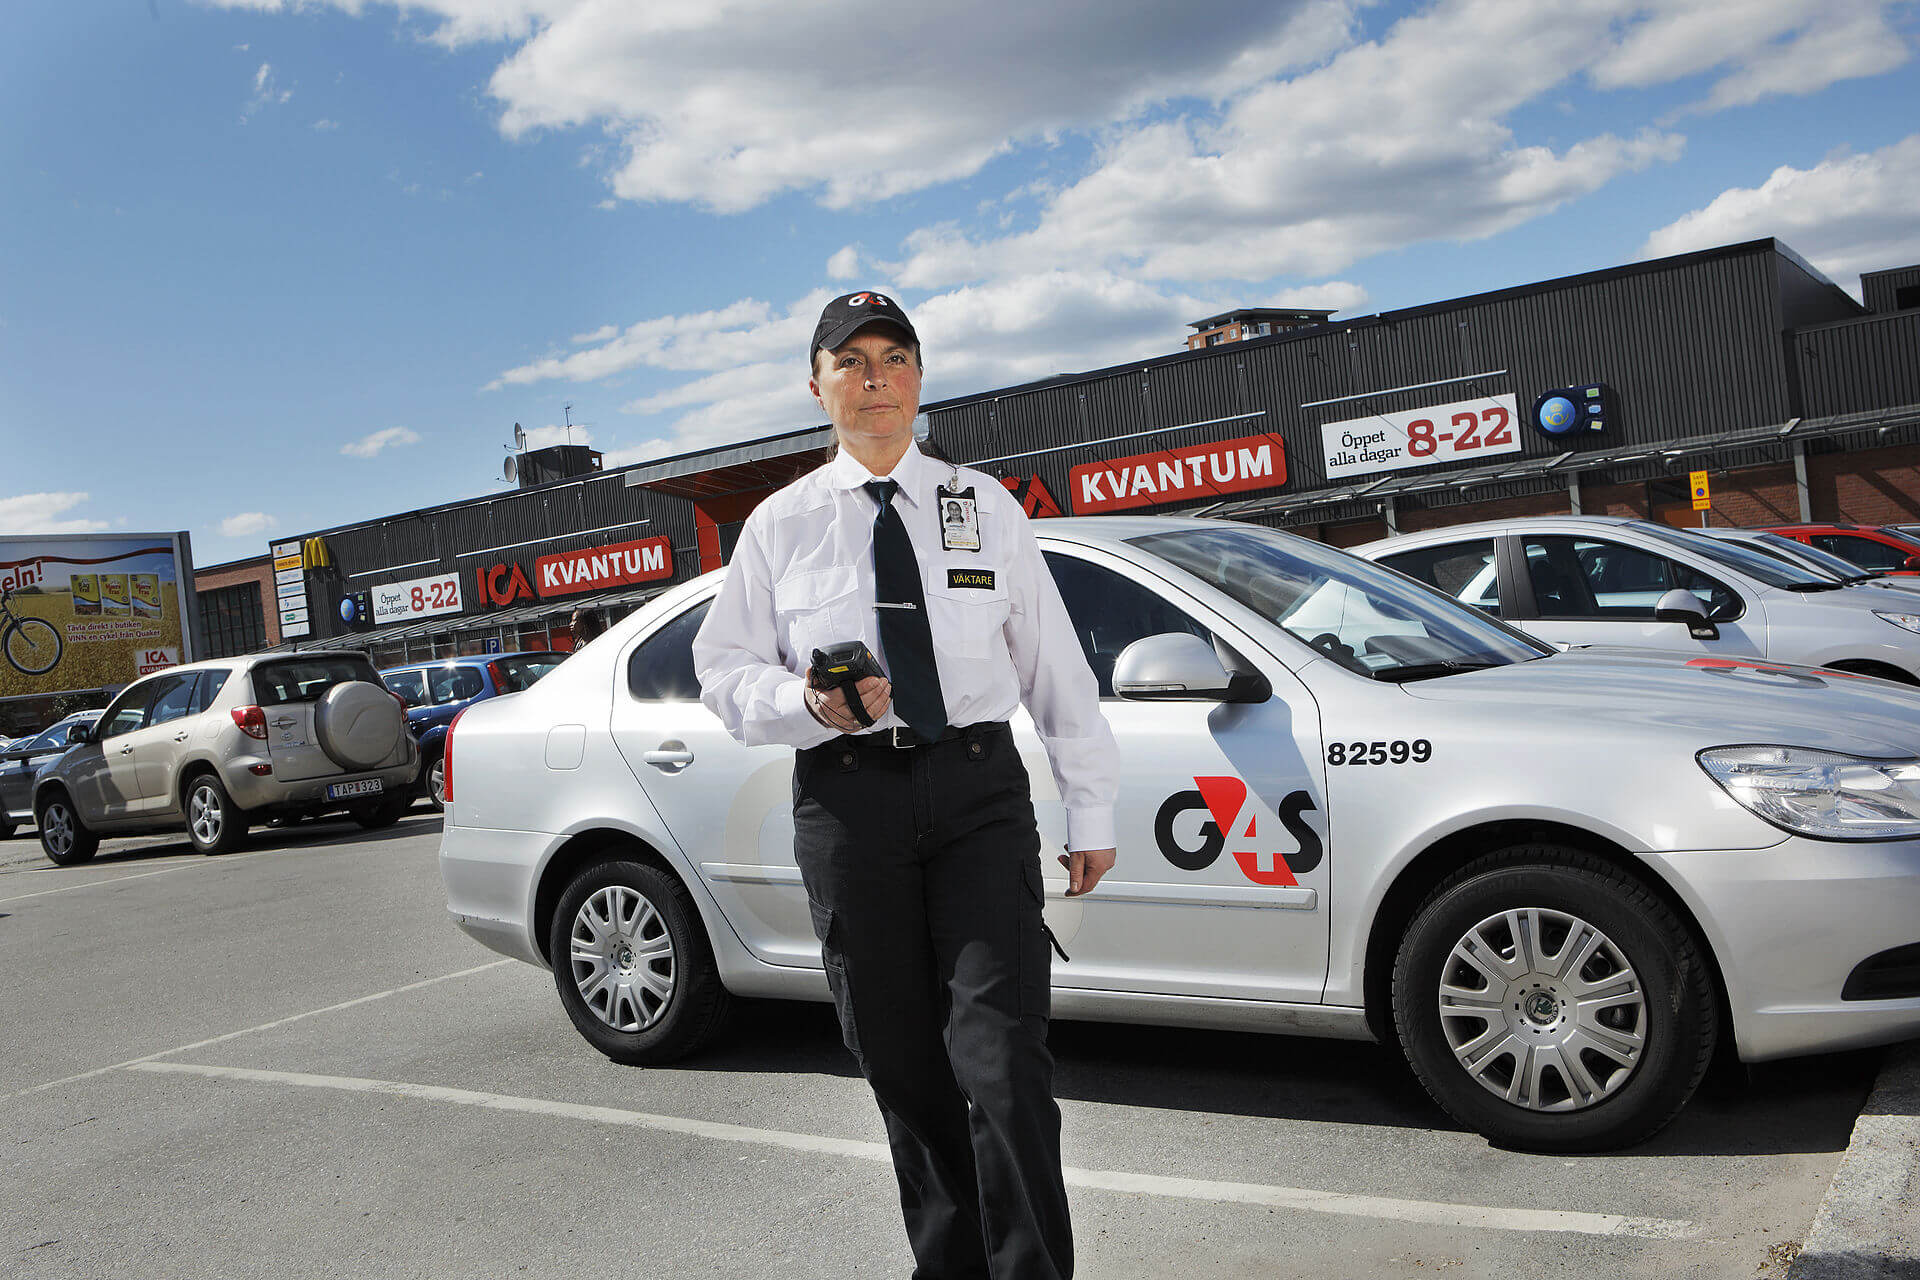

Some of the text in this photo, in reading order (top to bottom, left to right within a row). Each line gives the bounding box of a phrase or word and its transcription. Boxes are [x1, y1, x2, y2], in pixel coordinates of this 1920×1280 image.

[848, 293, 888, 307] G4S
[1341, 430, 1386, 449] Öppet
[1406, 407, 1512, 458] 8-22
[1329, 446, 1402, 468] alla dagar
[1081, 445, 1274, 504] KVANTUM
[0, 561, 43, 593] eln!
[543, 545, 665, 588] KVANTUM
[476, 561, 537, 607] ICA
[380, 593, 401, 605] Öppet
[410, 581, 458, 612] 8-22
[376, 603, 409, 617] alla dagar
[88, 623, 109, 631] direkt
[115, 621, 142, 629] butiken
[99, 631, 118, 642] cykel
[145, 650, 169, 665] ICA
[1327, 739, 1432, 766] 82599
[335, 780, 380, 796] TAP 323
[1154, 776, 1323, 886] G4S
